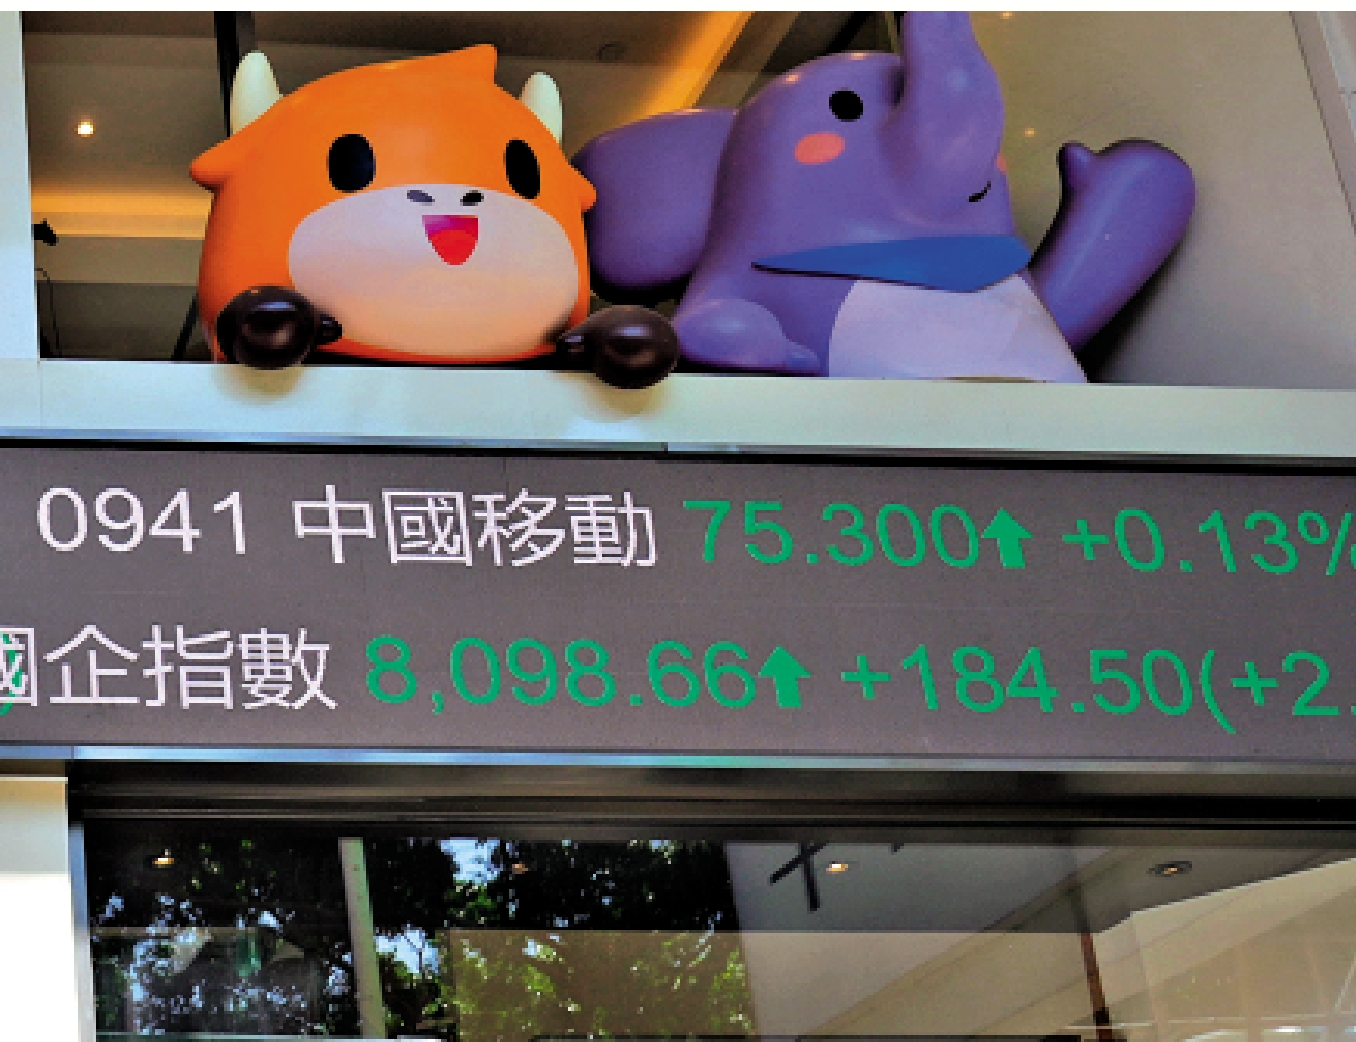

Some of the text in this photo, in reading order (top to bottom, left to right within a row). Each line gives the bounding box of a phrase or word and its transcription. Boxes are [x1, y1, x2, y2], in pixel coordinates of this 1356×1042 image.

[36, 485, 1356, 576] 0941 中國移動 75.300 +0.13%
[365, 636, 757, 714] 8,098.66
